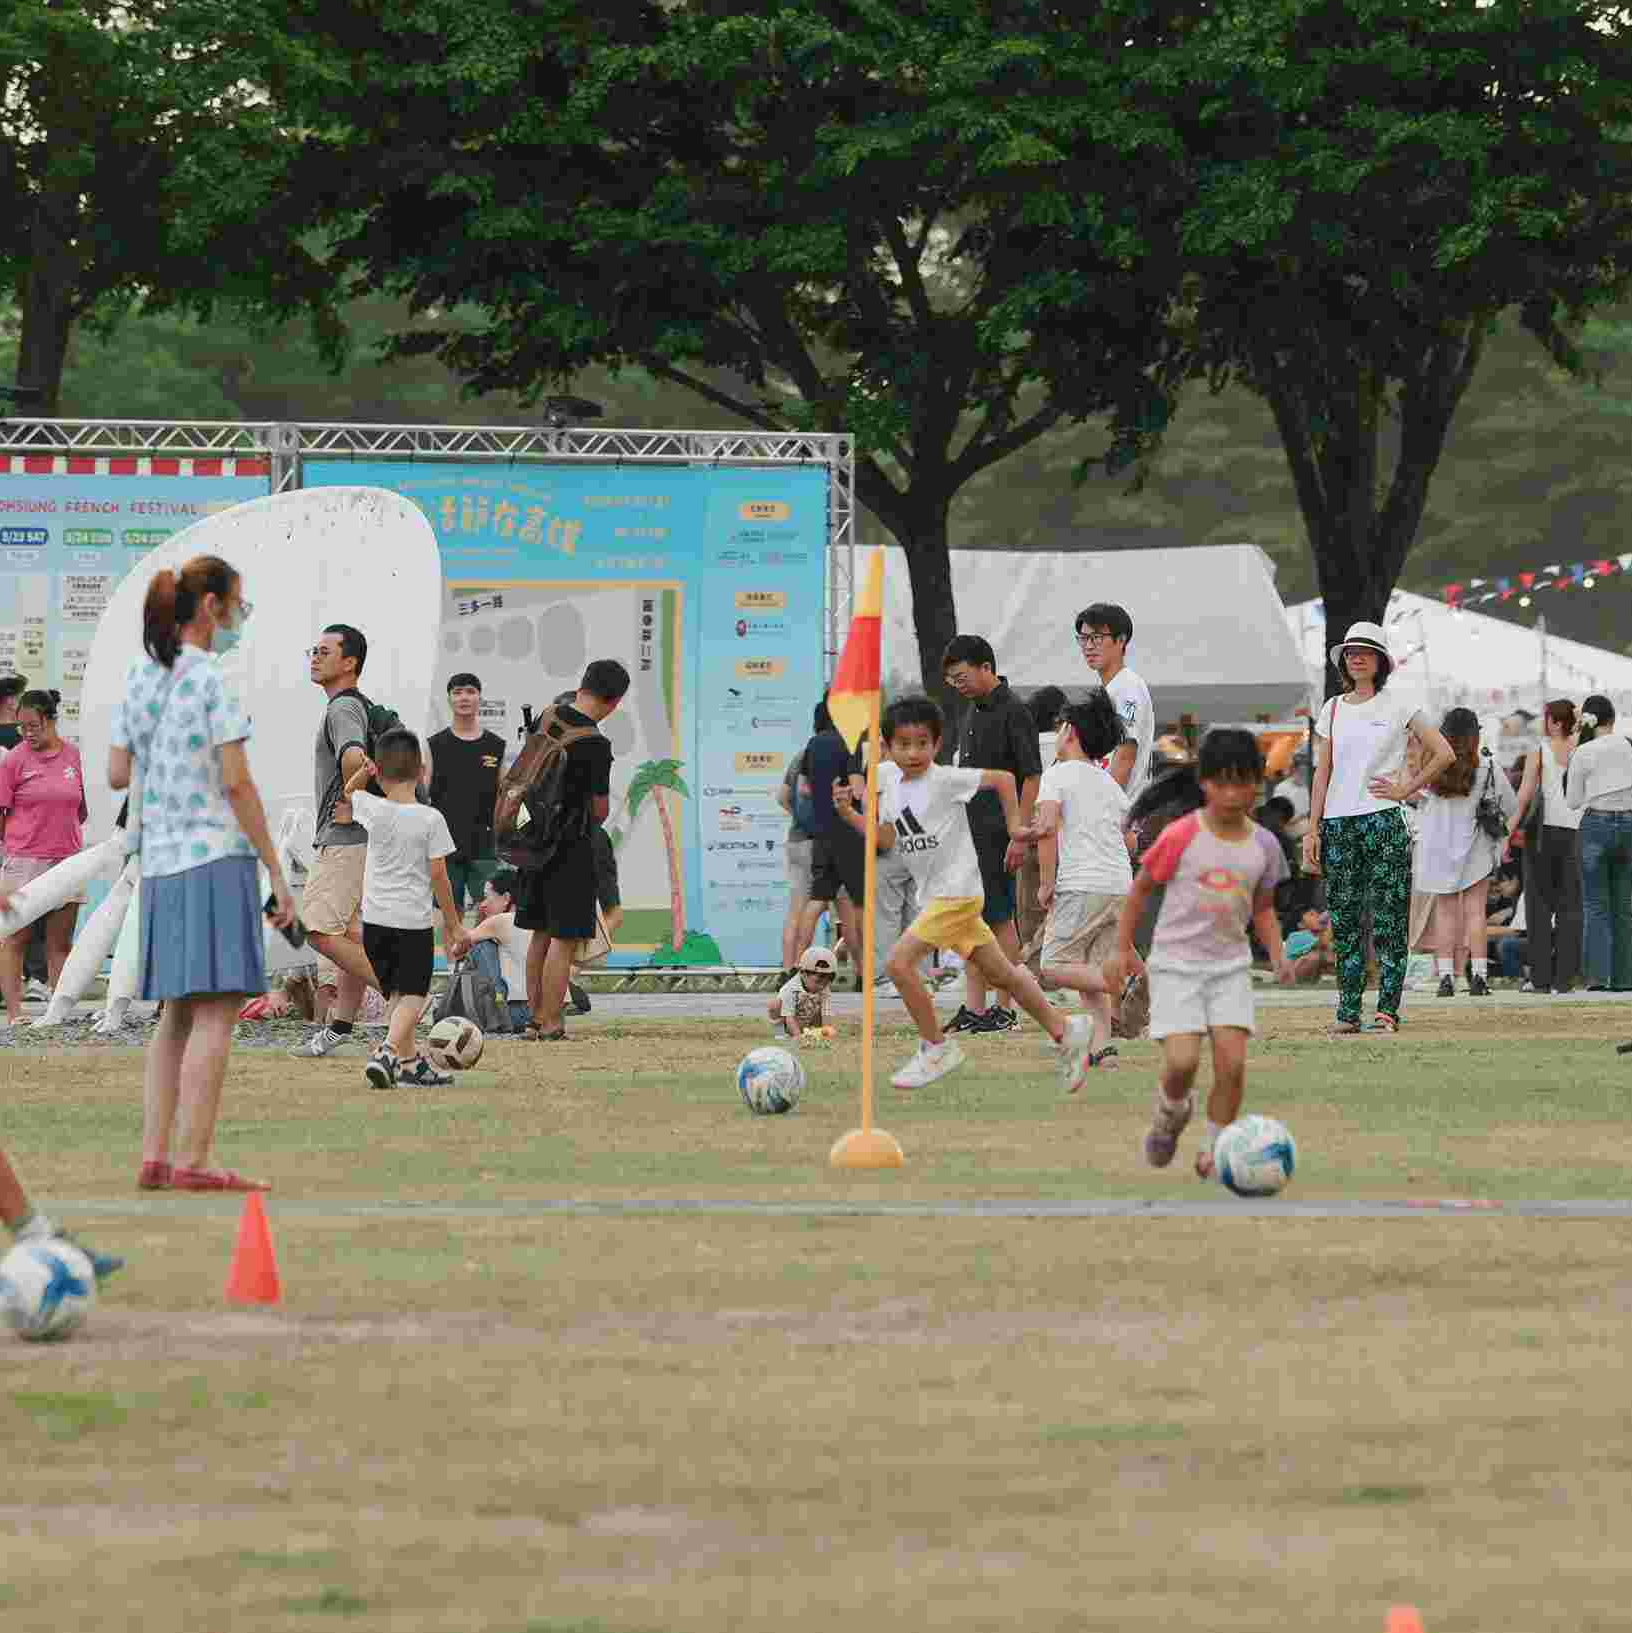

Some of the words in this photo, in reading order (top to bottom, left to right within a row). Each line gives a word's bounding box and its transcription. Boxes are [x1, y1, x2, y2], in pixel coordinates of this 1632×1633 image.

[64, 501, 120, 514] FRENCH
[129, 502, 199, 516] FESTIVAL
[458, 595, 503, 616] 三多一路
